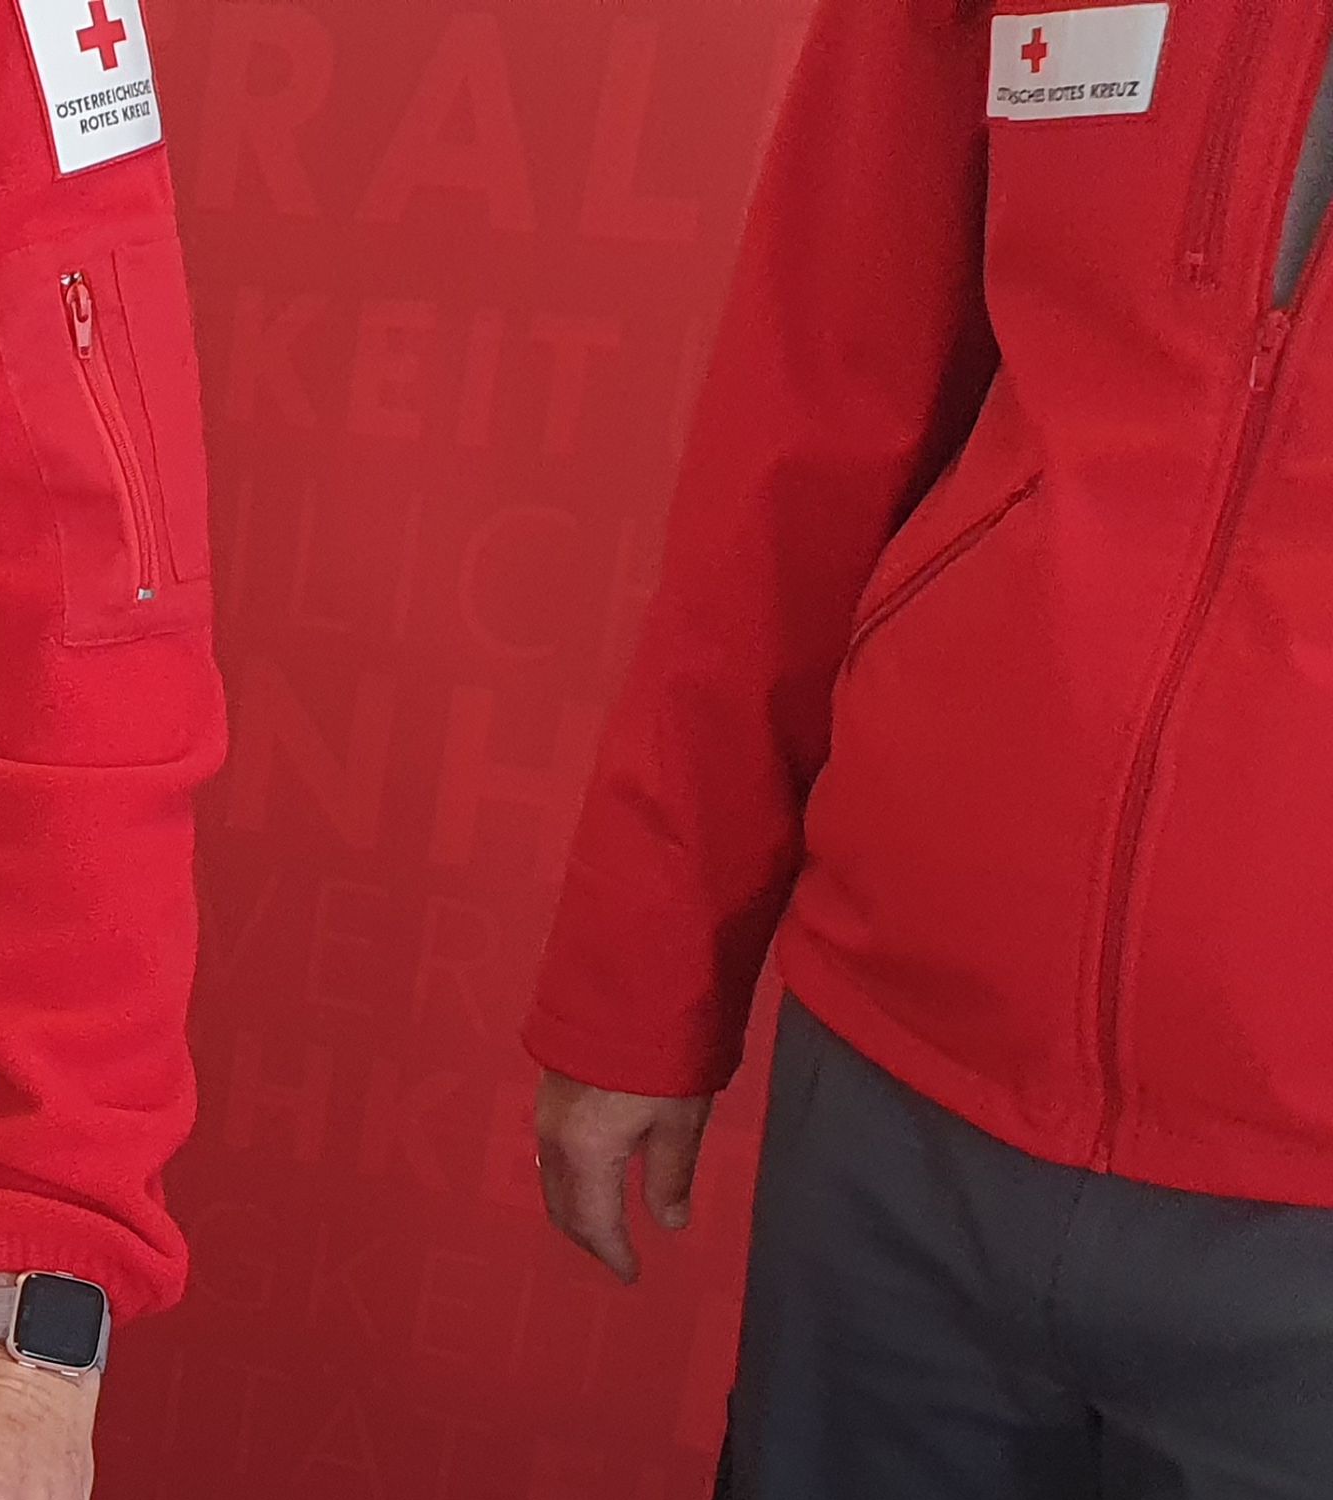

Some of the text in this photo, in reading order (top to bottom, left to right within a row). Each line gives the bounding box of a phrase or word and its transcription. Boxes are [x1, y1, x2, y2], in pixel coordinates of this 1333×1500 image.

[55, 79, 152, 118] ÖSTERREICHISCHE
[1090, 81, 1140, 98] KREUZ
[80, 100, 150, 134] ROTES KREUZ
